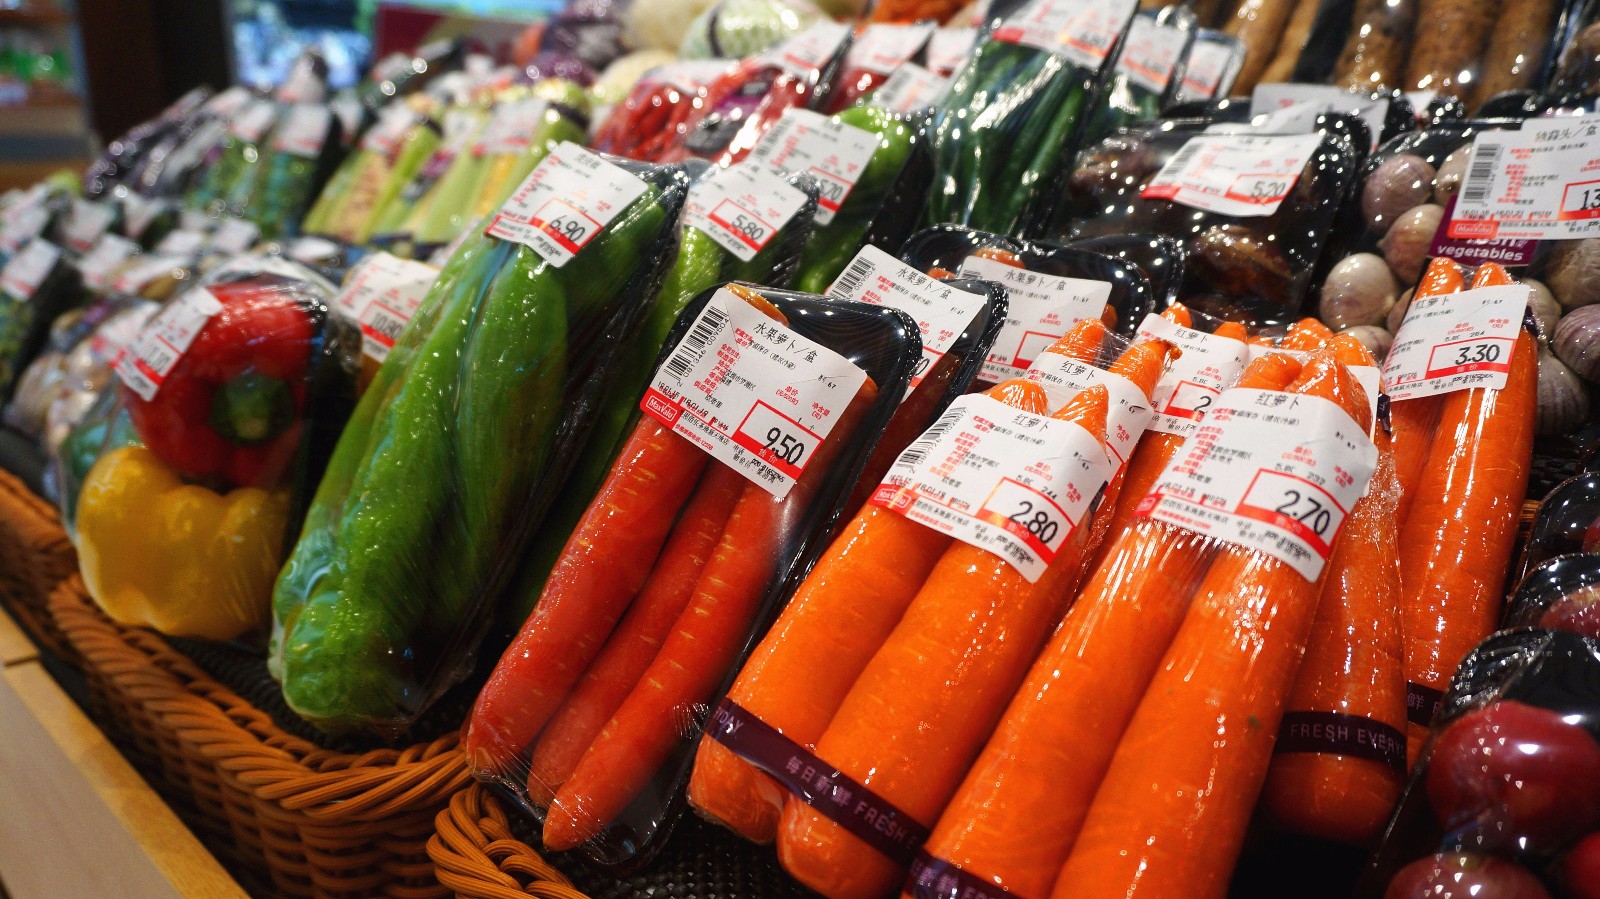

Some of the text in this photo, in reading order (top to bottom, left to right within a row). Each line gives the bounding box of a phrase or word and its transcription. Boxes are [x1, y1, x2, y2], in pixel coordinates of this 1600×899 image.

[1250, 181, 1286, 200] 5.20
[550, 214, 586, 243] 6.90
[731, 214, 765, 240] 5.80
[1437, 245, 1524, 261] vegetables
[752, 319, 819, 365] 水果萝卜／盒
[1175, 327, 1208, 343] 红萝卜
[1455, 344, 1500, 365] 3.30
[1060, 360, 1095, 380] 红萝卜
[647, 395, 676, 419] MaxValu
[1255, 393, 1300, 411] 红萝卜
[1014, 413, 1048, 432] 红萝卜
[759, 424, 807, 468] 9.50
[1008, 500, 1059, 545] 2.80
[1275, 490, 1331, 537] 2.70
[1290, 722, 1348, 742] FRESH
[853, 802, 906, 841] FRESH
